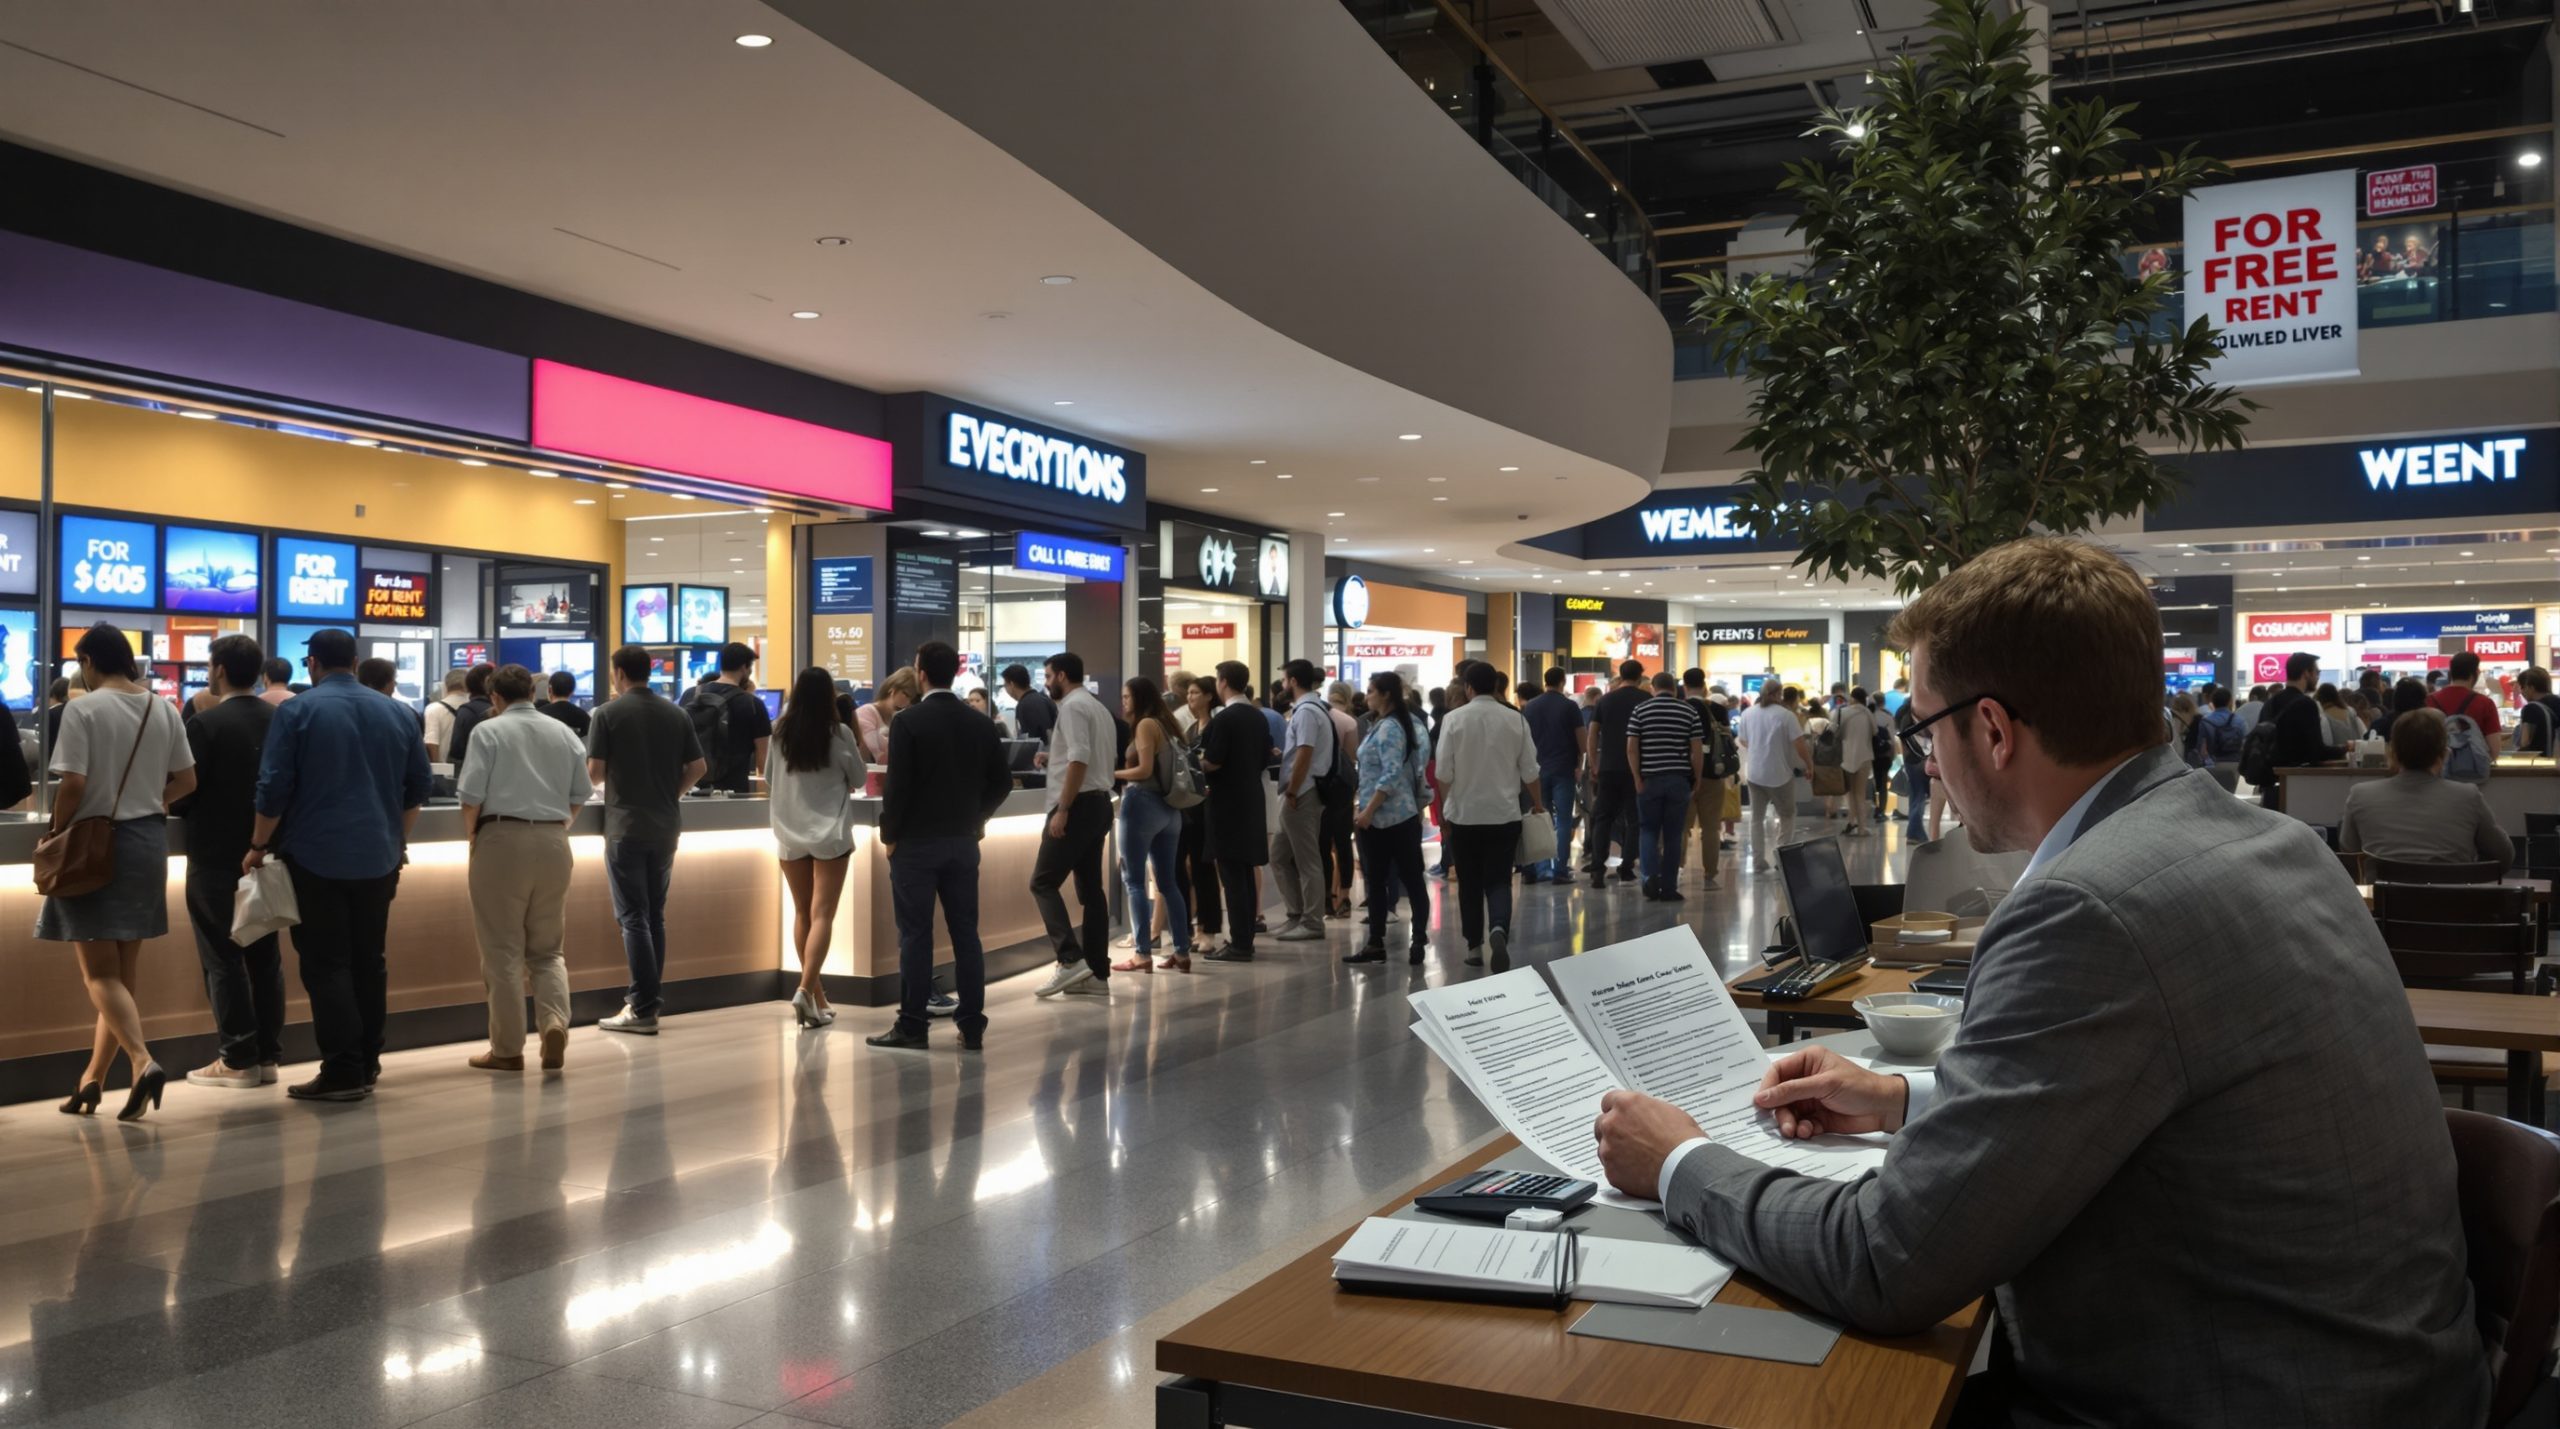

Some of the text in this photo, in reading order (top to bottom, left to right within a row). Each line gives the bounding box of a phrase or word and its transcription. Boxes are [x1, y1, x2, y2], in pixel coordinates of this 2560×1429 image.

[2215, 208, 2321, 252] FOR
[2204, 243, 2338, 293] FREE
[2225, 289, 2323, 323] RENT
[2292, 324, 2342, 343] LIVER
[949, 412, 1126, 504] EVECRYTIONS
[2359, 438, 2526, 491] WEENT
[88, 539, 130, 562] FOR
[295, 553, 336, 577] FOR
[289, 576, 349, 606] RENT
